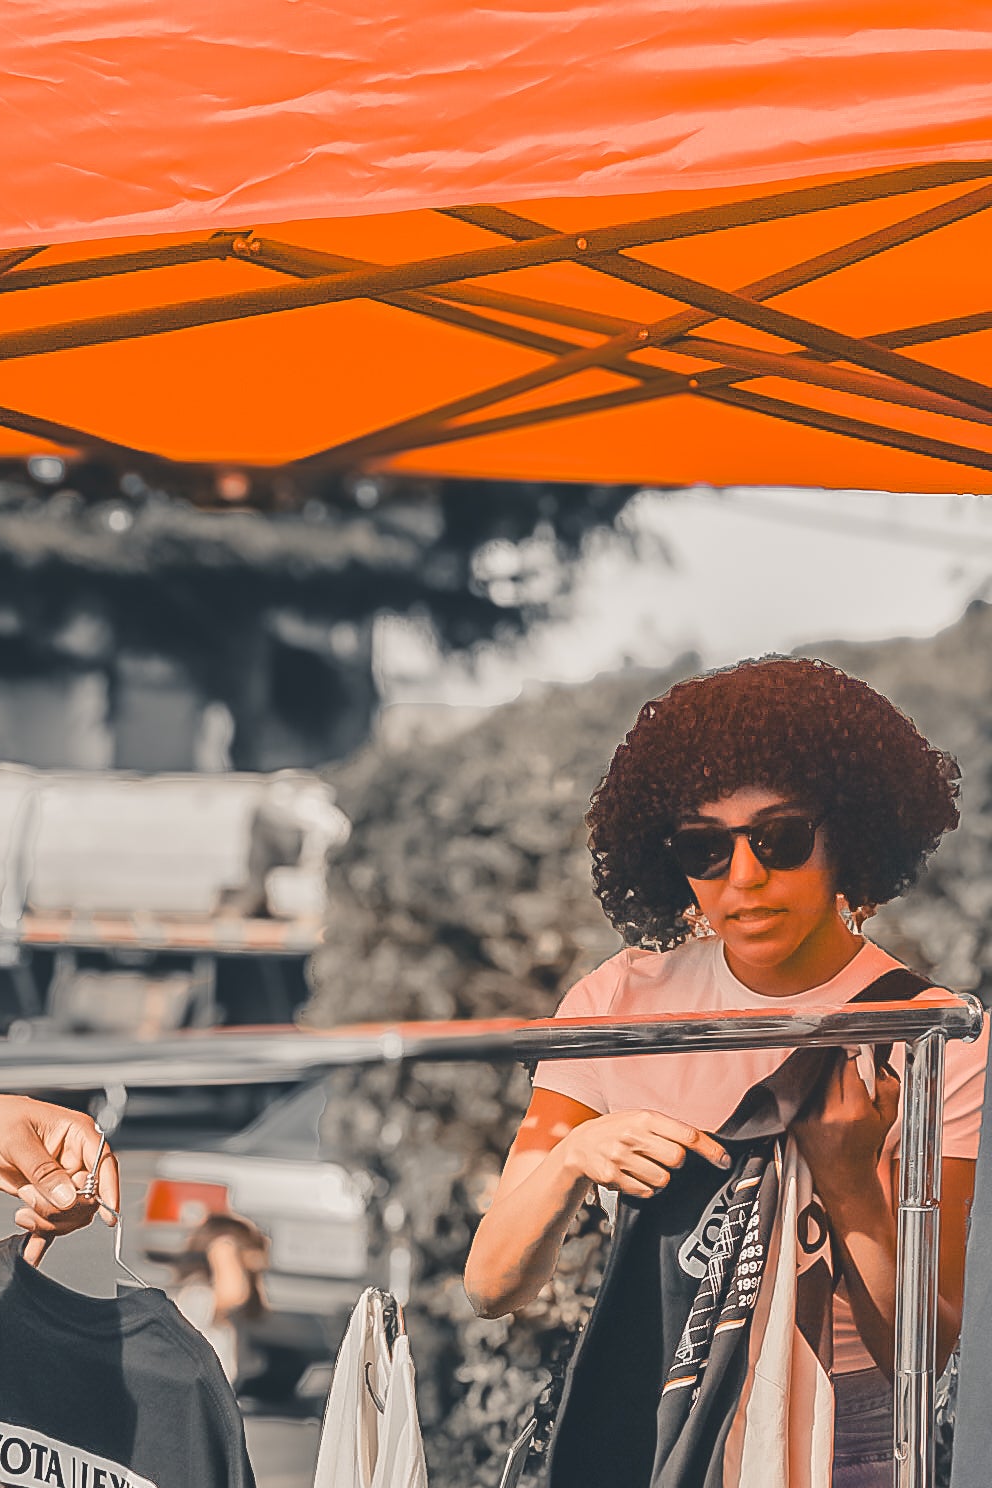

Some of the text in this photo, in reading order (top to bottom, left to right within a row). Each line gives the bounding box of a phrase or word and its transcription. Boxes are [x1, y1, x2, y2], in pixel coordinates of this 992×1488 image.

[686, 1180, 736, 1266] TOY
[737, 1261, 764, 1277] 1997
[737, 1276, 762, 1292] 199
